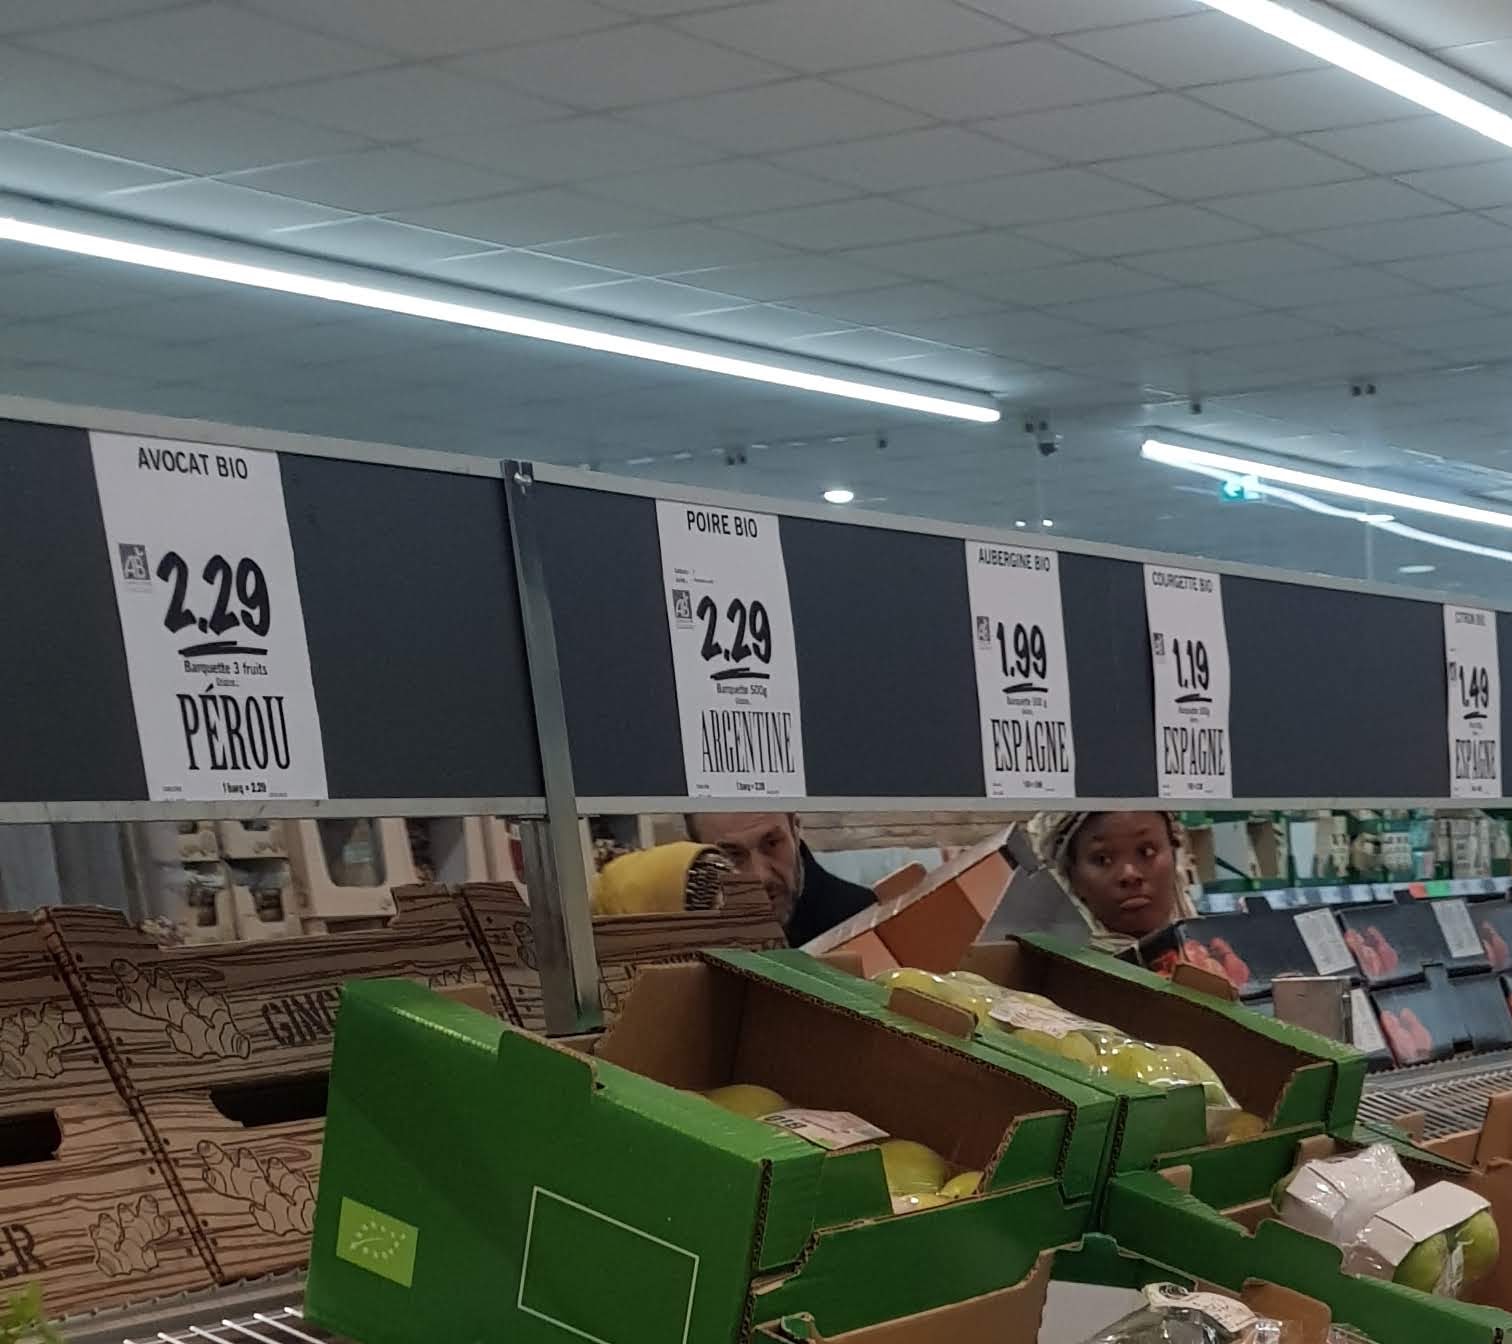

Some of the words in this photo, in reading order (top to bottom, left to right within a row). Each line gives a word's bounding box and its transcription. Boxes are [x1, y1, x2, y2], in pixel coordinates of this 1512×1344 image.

[138, 447, 209, 476] AVOCAT
[215, 456, 249, 479] BIO
[686, 510, 731, 536] POIRE
[734, 516, 758, 538] BIO
[979, 548, 1033, 570] AUBERGINE
[1034, 555, 1050, 572] BIO
[156, 551, 271, 637] 2.29
[696, 595, 772, 664] 2.29
[996, 622, 1047, 679] 1.99
[242, 662, 269, 677] fruits
[1172, 638, 1209, 690] 1.19
[1459, 665, 1489, 708] 1.49
[176, 683, 291, 771] PÉROU
[701, 709, 796, 774] ARGENTINE
[990, 718, 1069, 772] ESPAGNE
[1163, 726, 1225, 776] ESPAGNE
